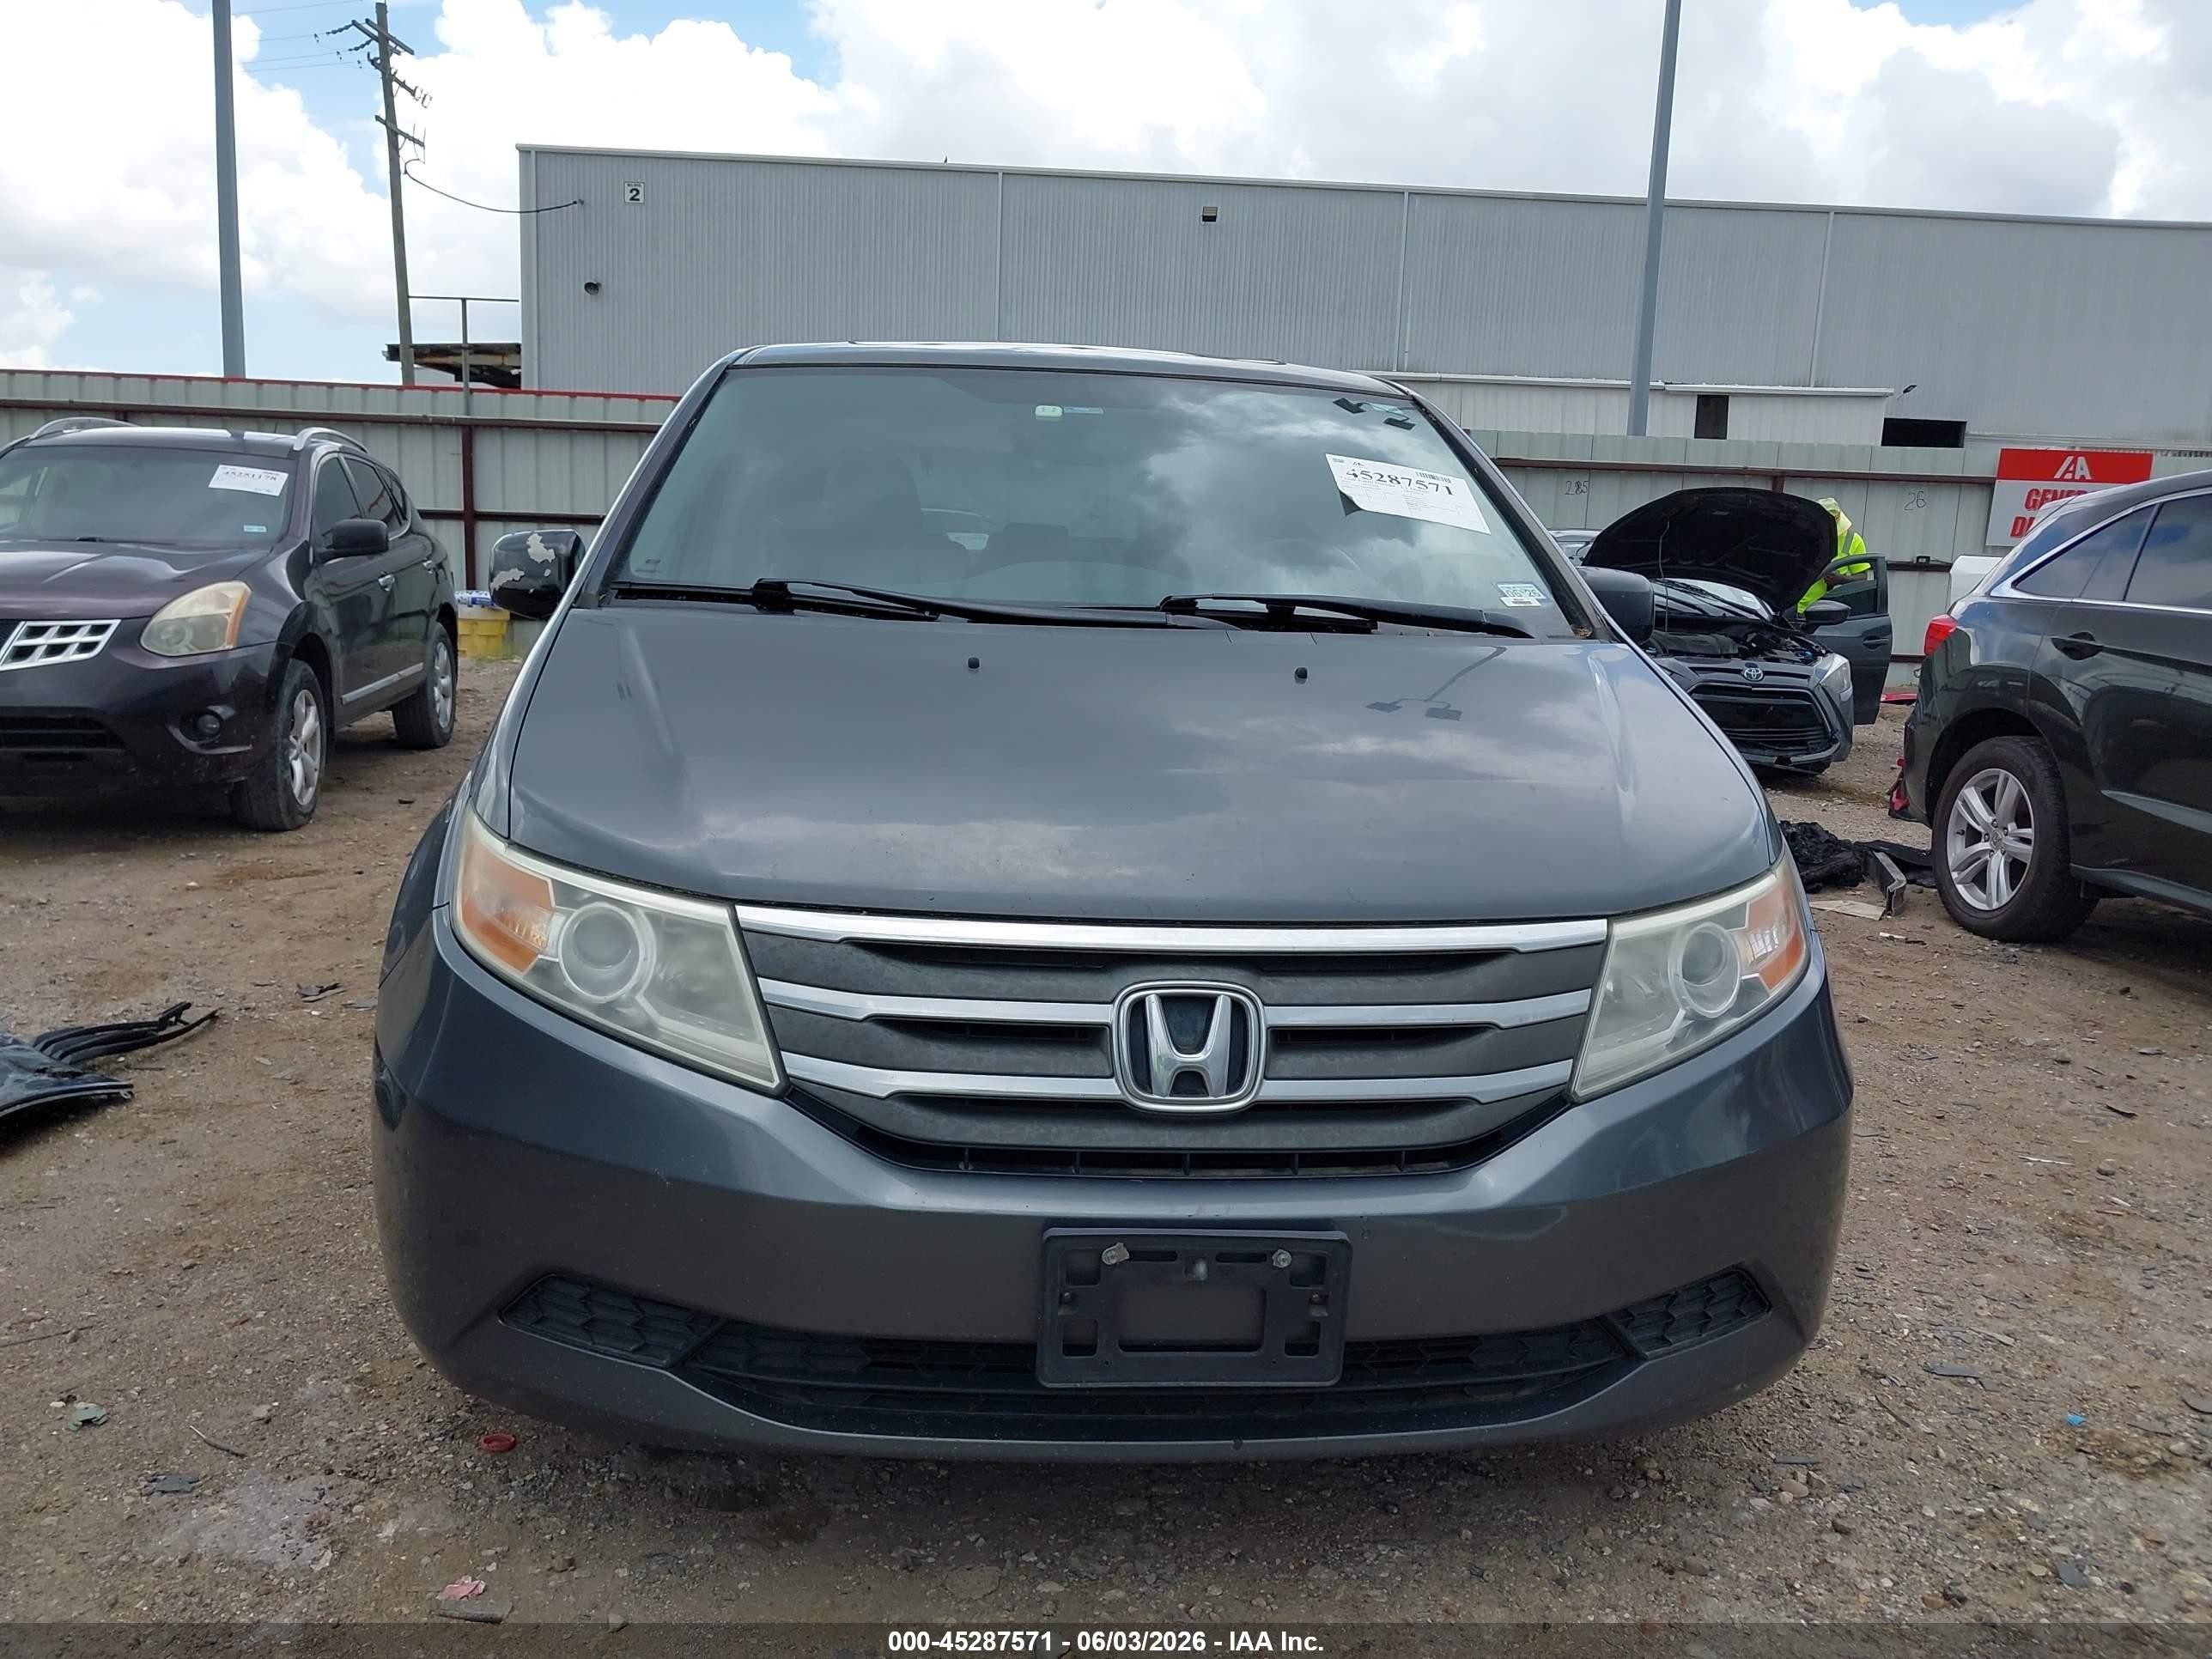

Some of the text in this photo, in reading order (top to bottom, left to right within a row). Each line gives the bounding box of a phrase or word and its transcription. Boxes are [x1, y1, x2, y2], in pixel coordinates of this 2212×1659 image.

[629, 188, 640, 202] 2
[1346, 469, 1455, 495] 45287571
[1904, 490, 1926, 511] 26
